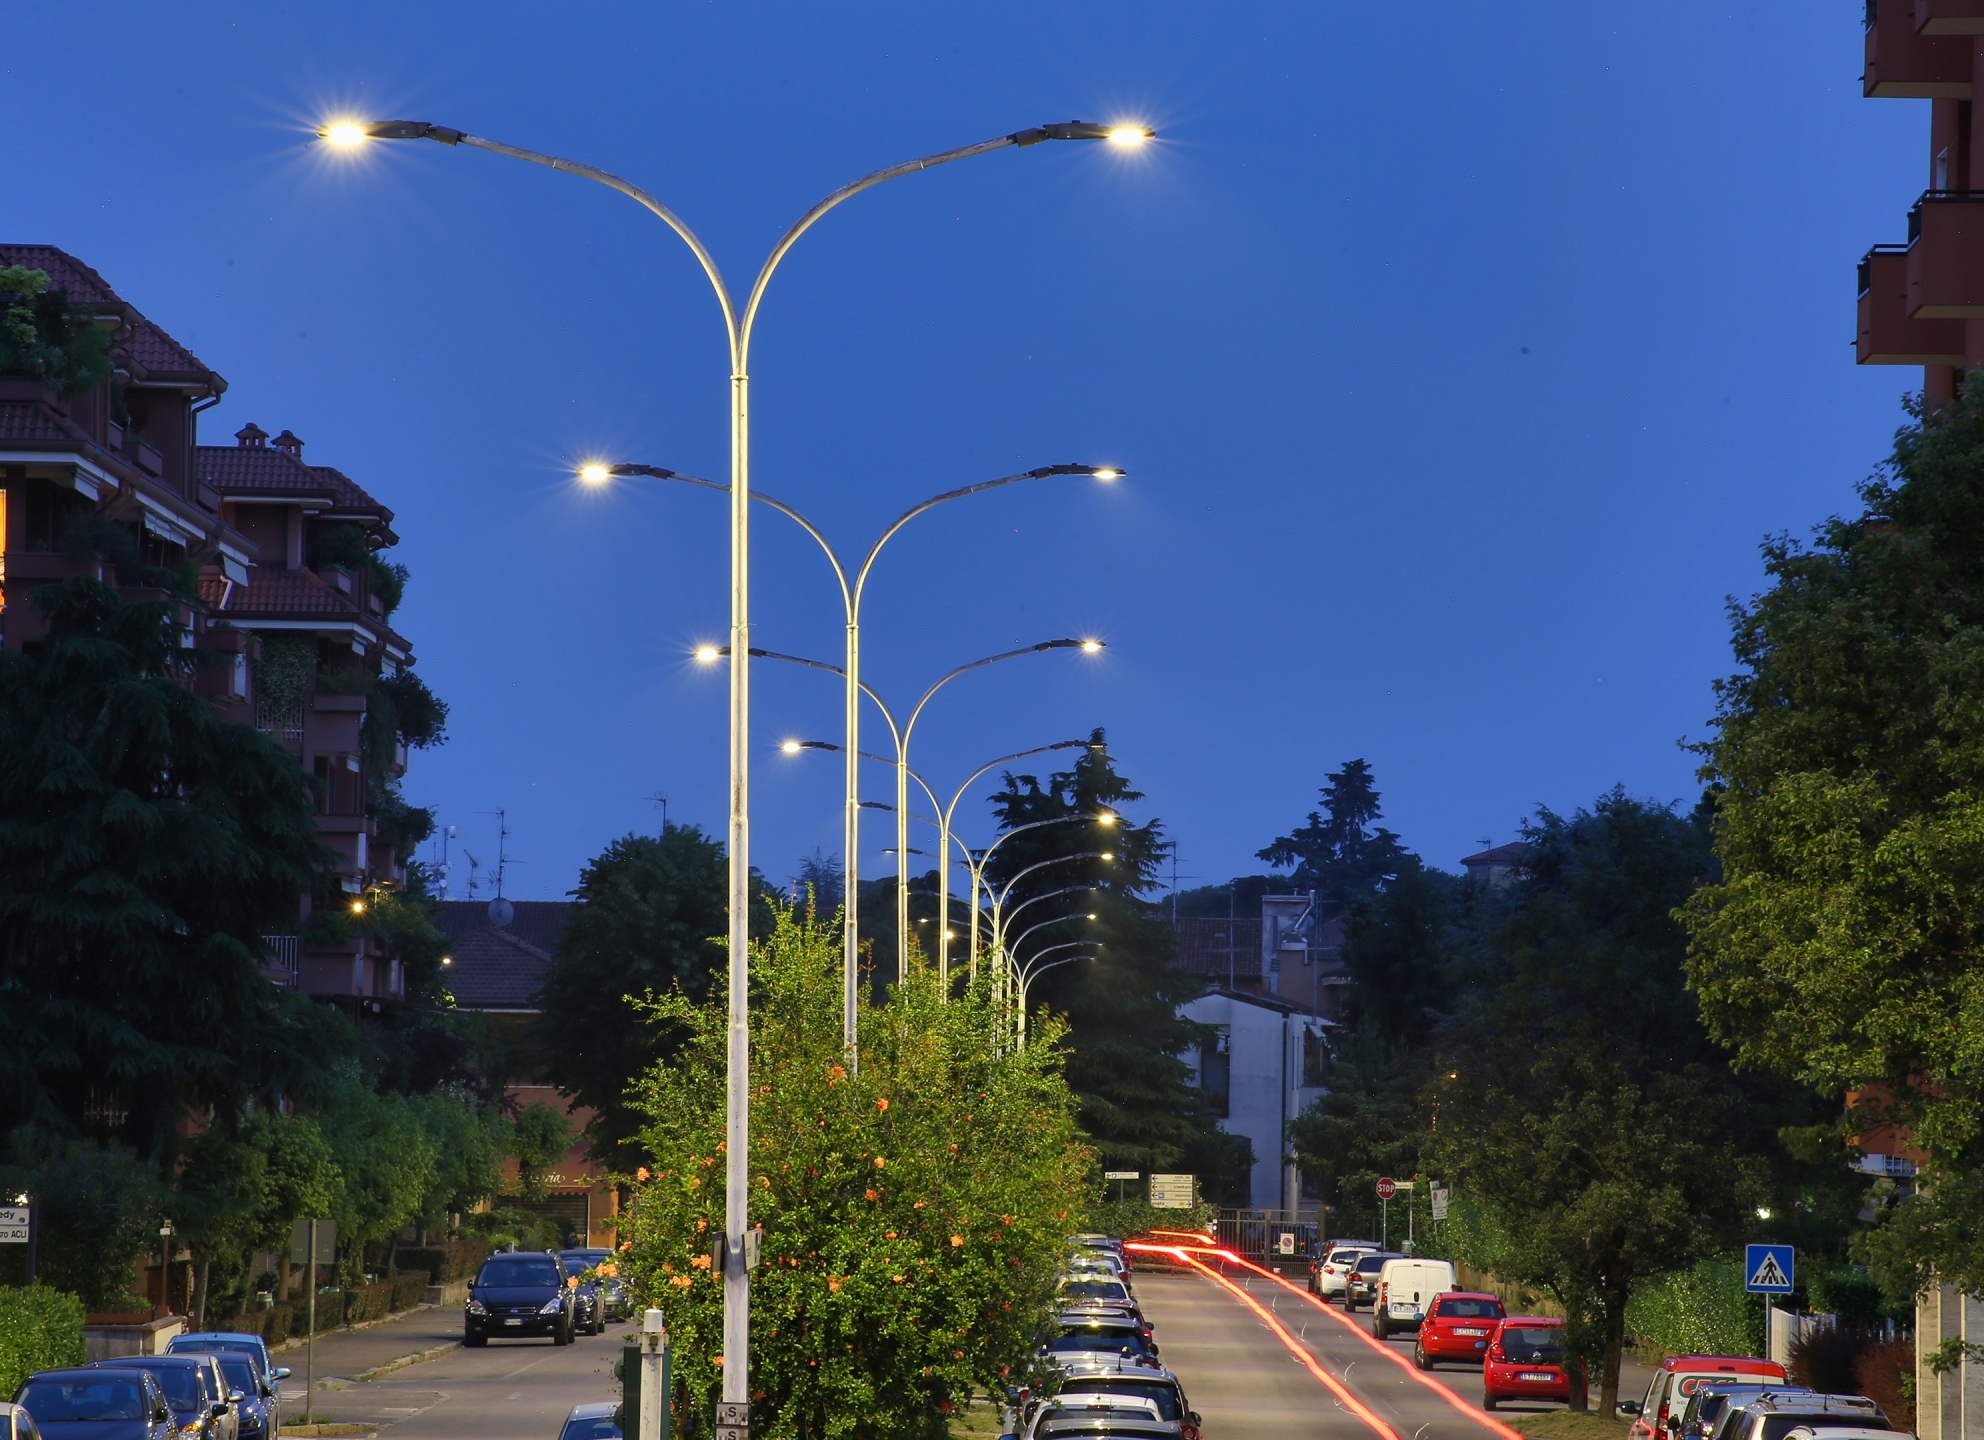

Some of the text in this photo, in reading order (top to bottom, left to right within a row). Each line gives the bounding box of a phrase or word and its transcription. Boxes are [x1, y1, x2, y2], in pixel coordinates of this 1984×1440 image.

[1378, 1184, 1395, 1192] STOP
[11, 1230, 27, 1238] ACLI
[728, 1406, 737, 1417] S
[728, 1430, 737, 1440] S
